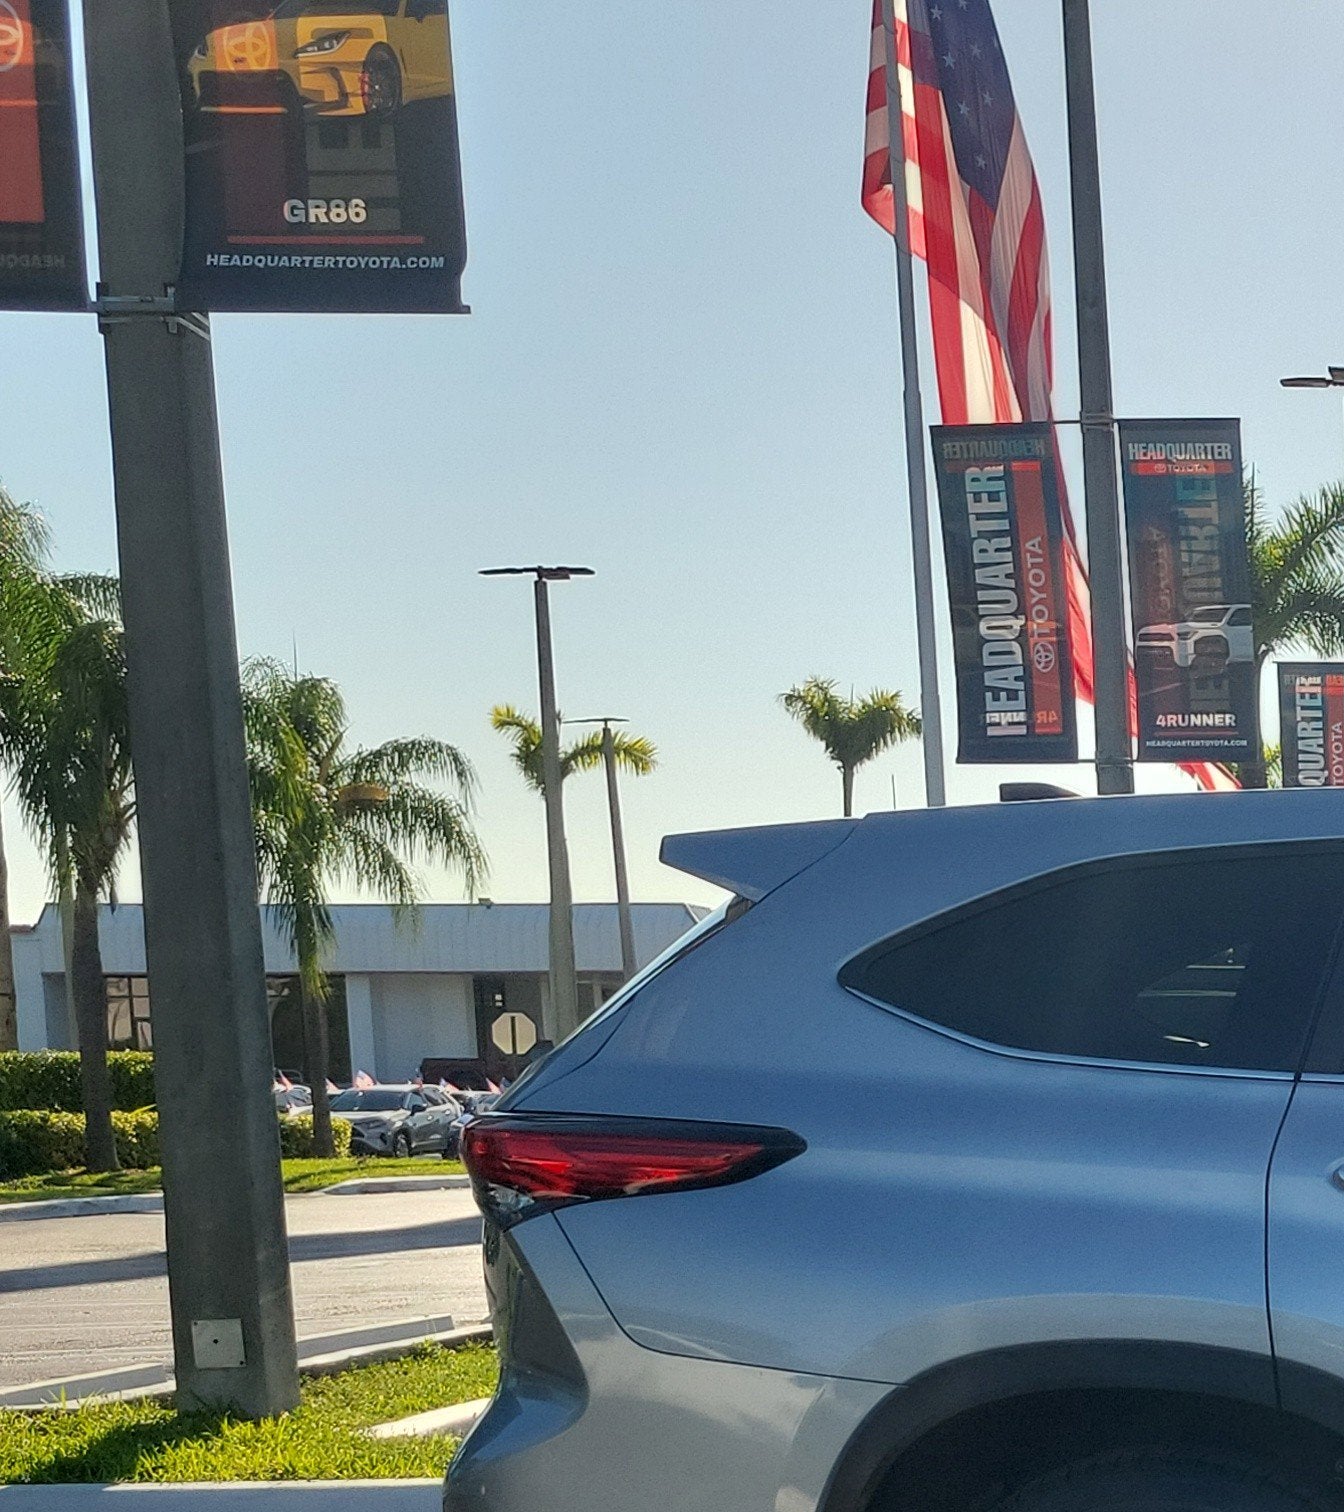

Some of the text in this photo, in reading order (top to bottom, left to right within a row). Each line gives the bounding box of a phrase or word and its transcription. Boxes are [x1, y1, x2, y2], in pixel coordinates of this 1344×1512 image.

[282, 198, 367, 223] GR86
[206, 253, 445, 269] HEADQUARTERTOYOTA.COM
[1128, 442, 1233, 461] HEADQUARTER
[1167, 463, 1207, 472] TOYOTA
[1024, 536, 1050, 633] TOYOTA
[965, 464, 1028, 736] HEADQUARTER
[1156, 713, 1237, 727] 4RUNNER
[1331, 721, 1344, 785] TOYOTA
